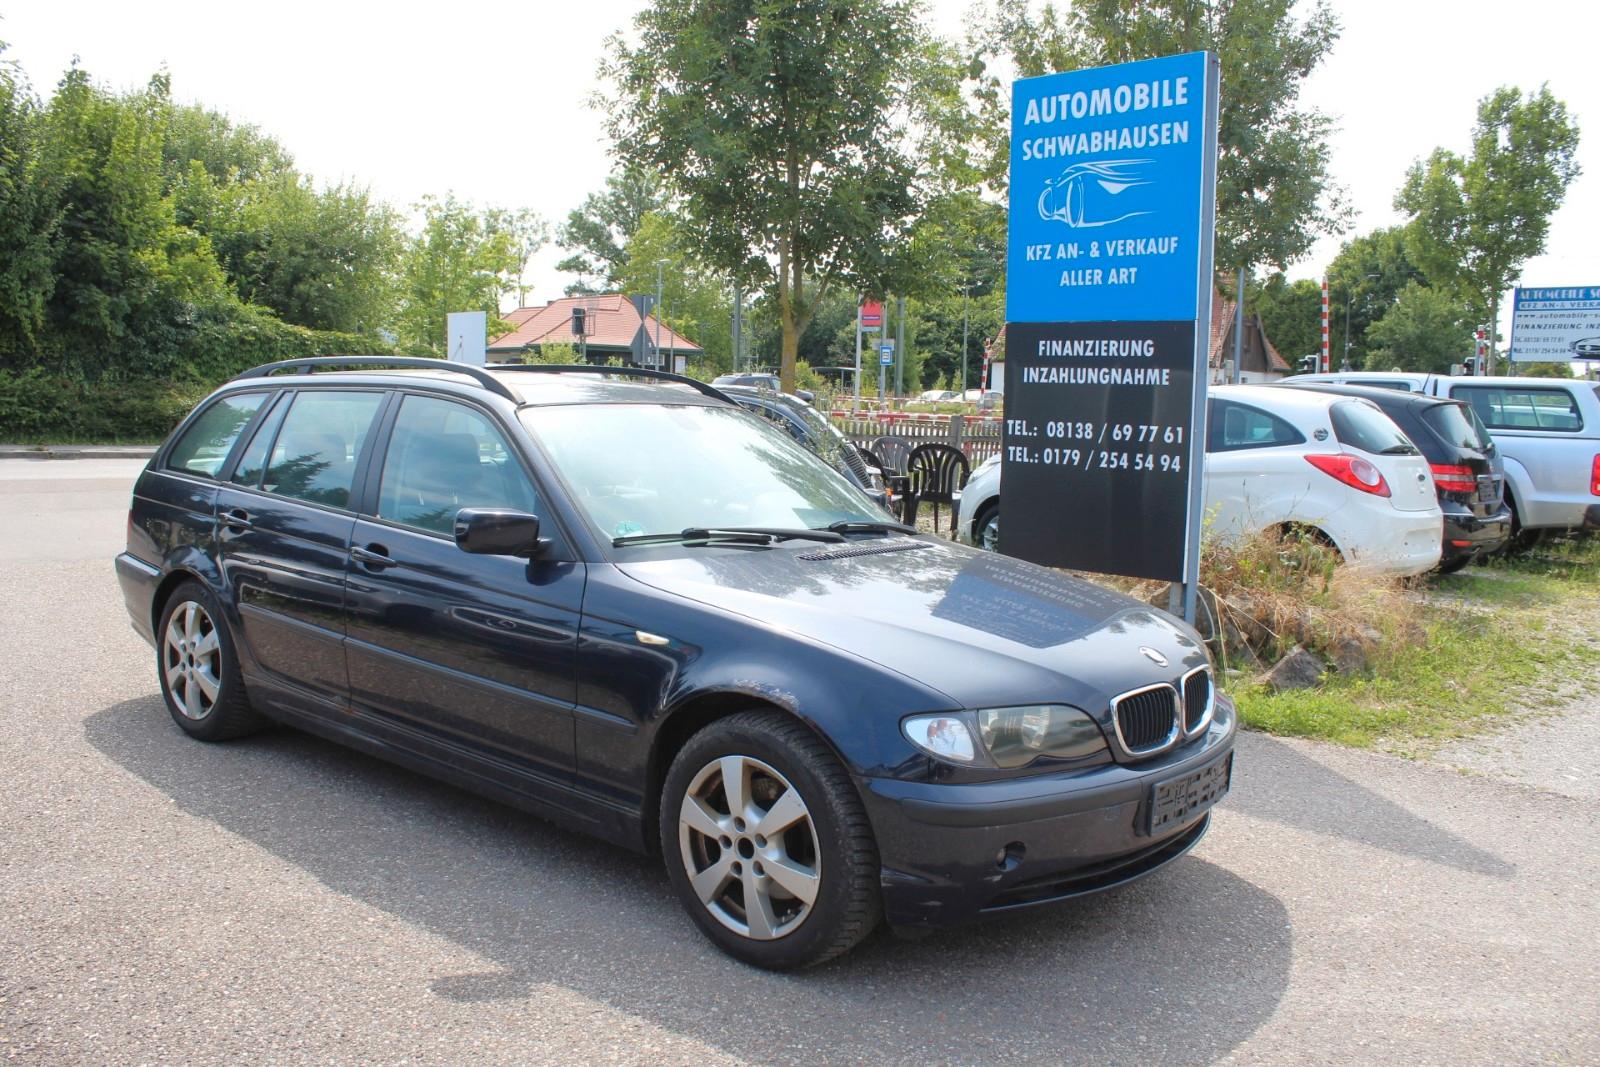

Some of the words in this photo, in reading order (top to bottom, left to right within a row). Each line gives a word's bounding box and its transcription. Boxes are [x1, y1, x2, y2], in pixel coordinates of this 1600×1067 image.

[1024, 77, 1189, 126] AUTOMOBILE
[1022, 121, 1189, 161] SCHWABHAUSEN
[1026, 244, 1052, 261] KFZ
[1056, 243, 1084, 260] AN-
[1090, 241, 1100, 258] &
[1106, 237, 1178, 257] VERKAUF
[1060, 269, 1103, 287] ALLER
[1108, 267, 1138, 285] ART
[1038, 340, 1155, 357] FINANZIERUNG
[1023, 367, 1170, 386] INZAHLUNGNAHME
[1007, 419, 1038, 437] TEL.:
[1046, 421, 1094, 440] 08138
[1098, 423, 1108, 444] /
[1112, 424, 1133, 442] 69
[1138, 425, 1159, 442] 77
[1163, 426, 1183, 444] 61
[1008, 446, 1039, 464] TEL.:
[1043, 448, 1081, 466] 0179
[1085, 450, 1095, 471] /
[1099, 451, 1129, 470] 254
[1134, 453, 1155, 471] 54
[1160, 455, 1181, 472] 94
